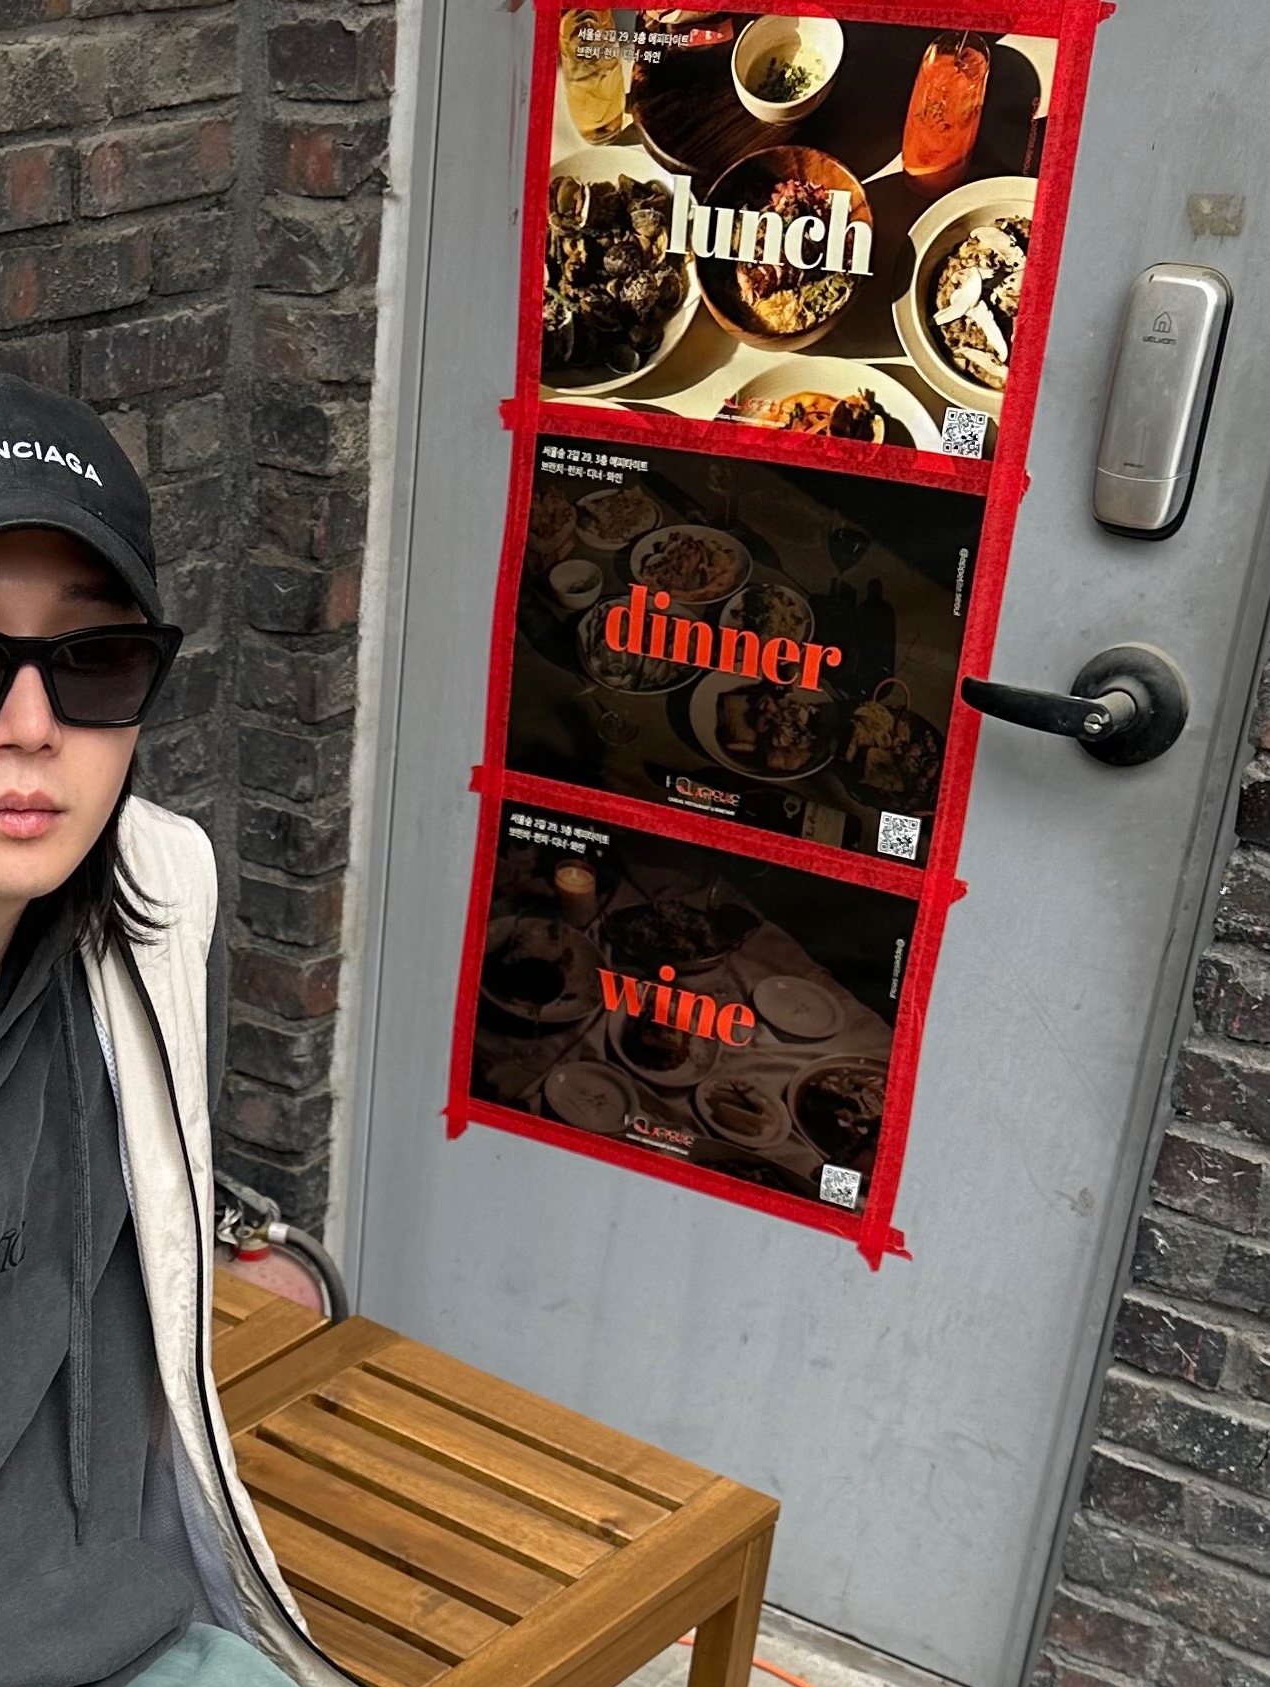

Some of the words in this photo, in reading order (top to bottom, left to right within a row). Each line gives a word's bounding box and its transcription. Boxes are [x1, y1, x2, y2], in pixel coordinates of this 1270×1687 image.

[666, 173, 874, 276] lunch
[605, 584, 842, 690] dinner
[600, 965, 755, 1046] wine
